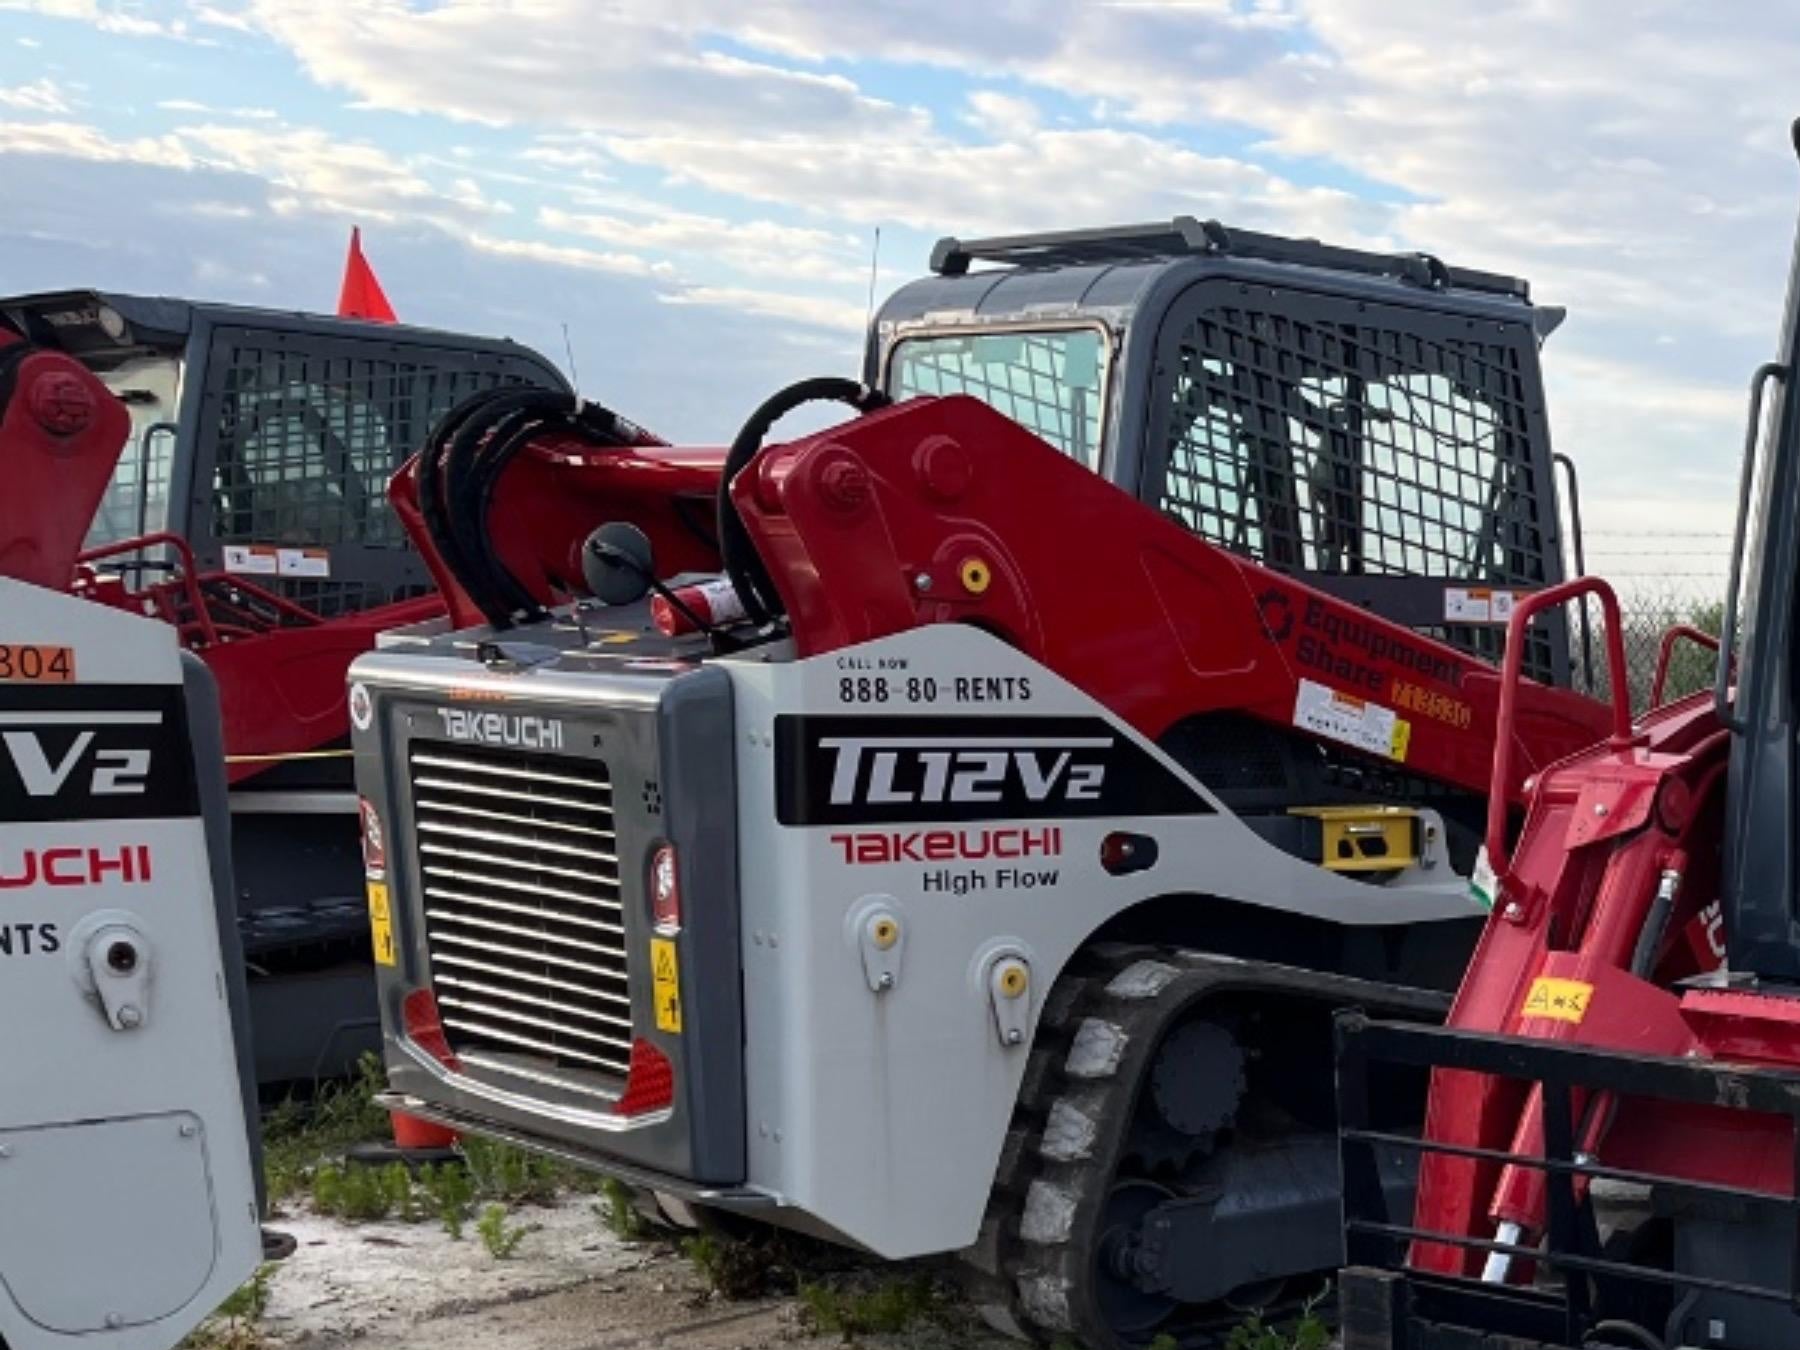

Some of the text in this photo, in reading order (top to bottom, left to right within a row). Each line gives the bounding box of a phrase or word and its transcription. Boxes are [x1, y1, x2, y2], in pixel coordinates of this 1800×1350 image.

[837, 657, 908, 670] CALL NOW
[1296, 634, 1384, 692] Share
[1303, 596, 1463, 688] Equipment
[819, 737, 1114, 805] TL12V2
[923, 869, 1059, 894] High Flow
